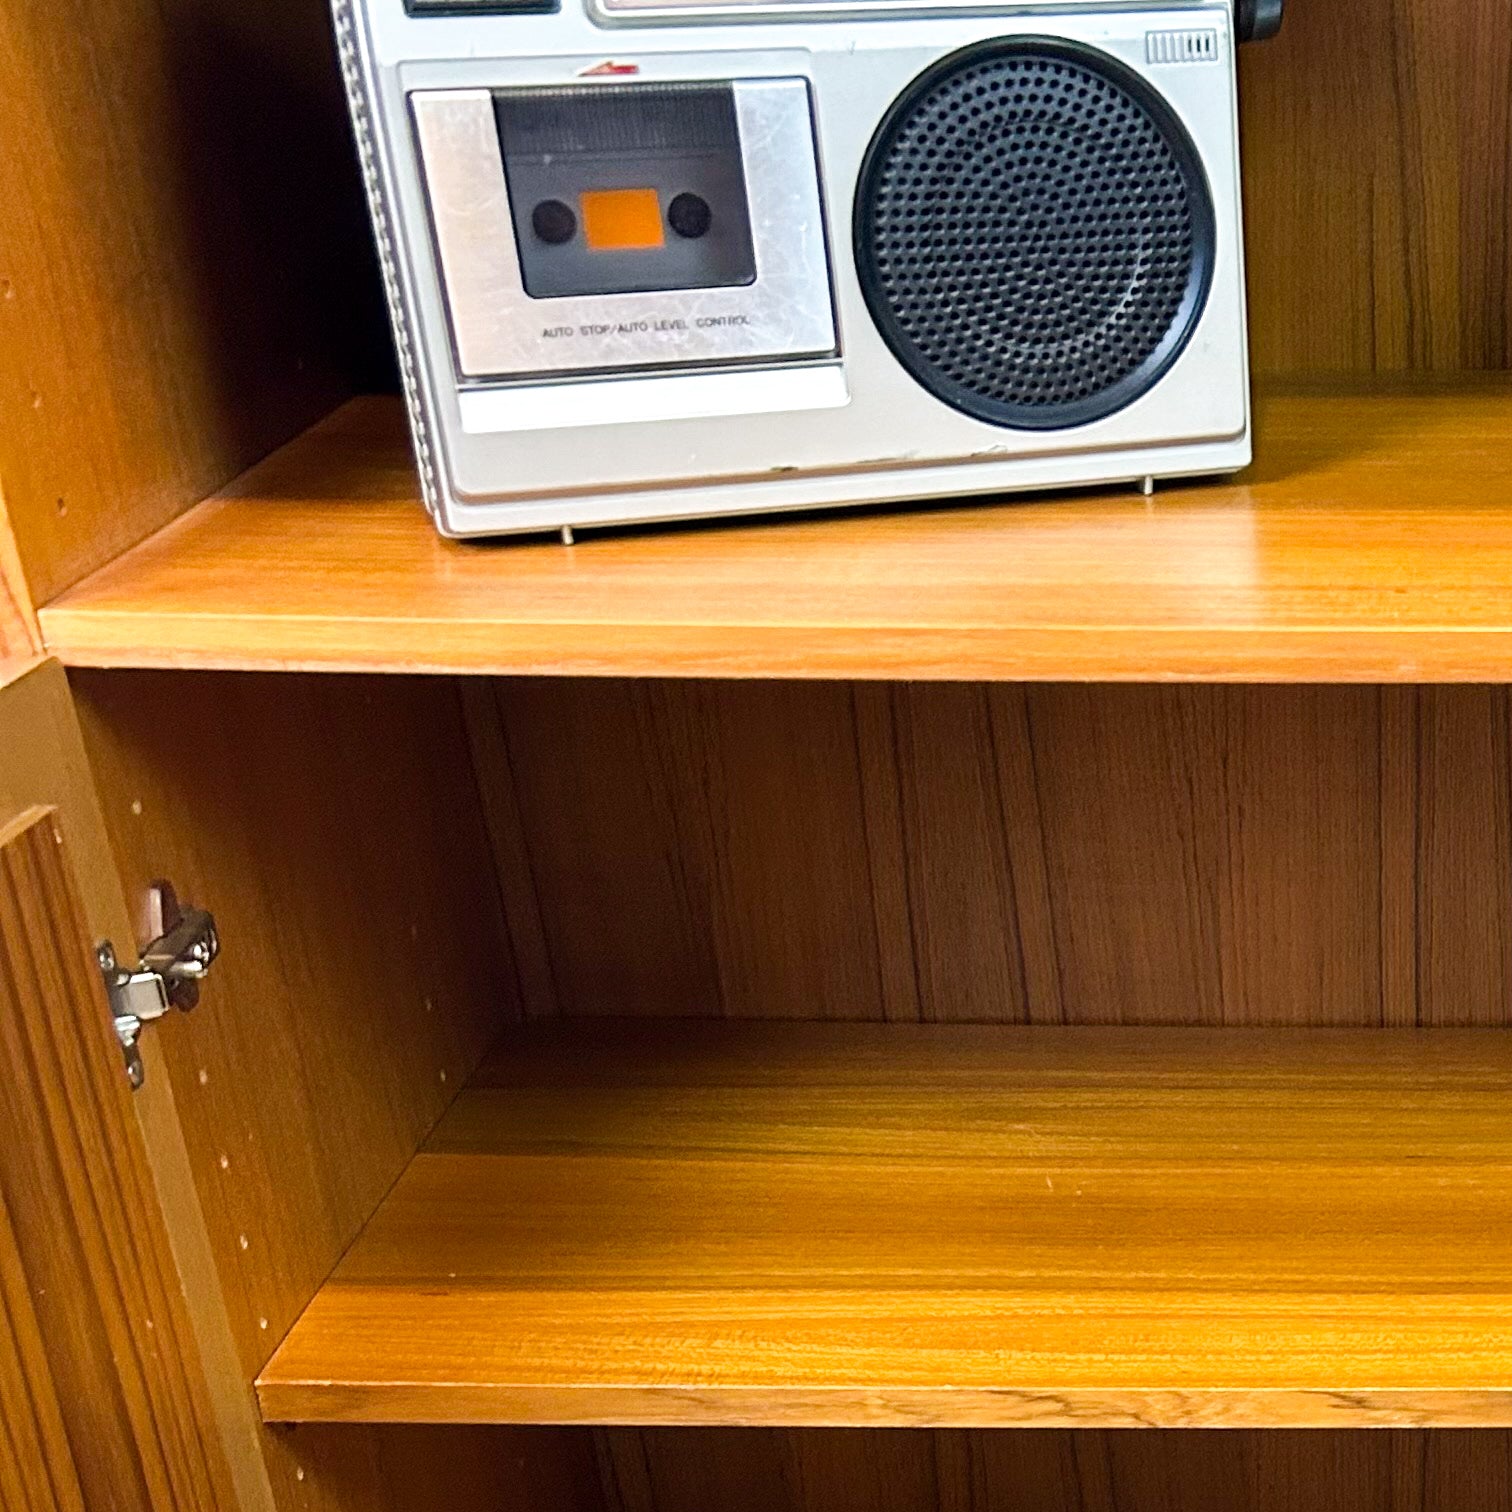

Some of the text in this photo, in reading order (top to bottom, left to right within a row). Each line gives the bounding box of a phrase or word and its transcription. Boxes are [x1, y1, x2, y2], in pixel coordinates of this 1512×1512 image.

[542, 315, 750, 339] AUTO STOP/AUTO LEVEL CONTROL
